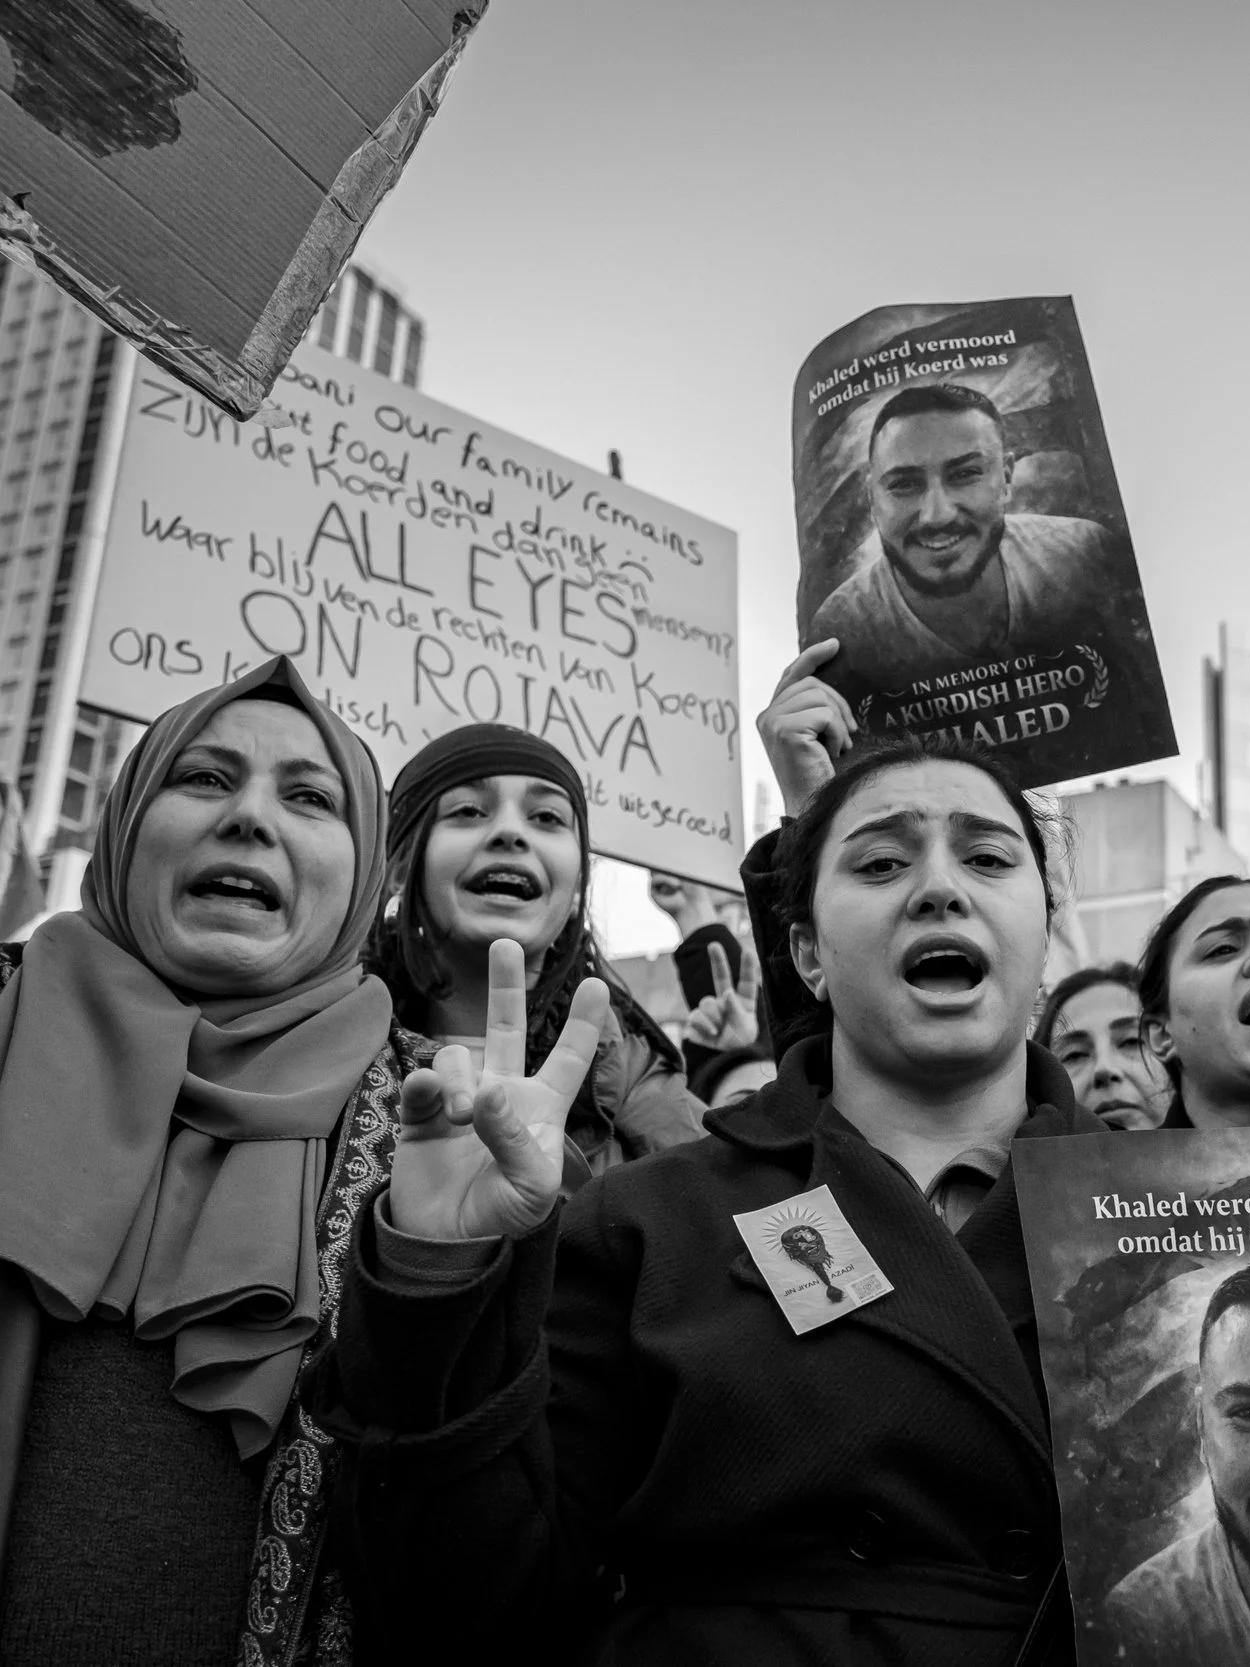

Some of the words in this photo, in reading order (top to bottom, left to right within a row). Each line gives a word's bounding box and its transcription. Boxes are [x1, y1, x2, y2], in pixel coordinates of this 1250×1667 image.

[807, 358, 860, 404] Khaled
[863, 341, 911, 368] werd
[915, 329, 1017, 353] vermoord
[816, 379, 871, 417] omdat
[873, 366, 901, 389] hij
[904, 352, 965, 379] Koerd
[969, 351, 1008, 367] was
[251, 427, 295, 467] de
[328, 421, 410, 485] food
[430, 479, 494, 516] and
[520, 505, 608, 568] drink
[461, 431, 574, 501] family
[583, 490, 704, 567] remains
[304, 501, 435, 598] ALL
[468, 543, 639, 659] EYES
[240, 589, 363, 680] ON
[386, 596, 423, 632] de
[432, 606, 547, 672] rechten
[885, 711, 899, 729] A
[899, 681, 1011, 727] KURDISH
[1014, 664, 1086, 697] HERO
[911, 680, 931, 695] IN
[935, 660, 1010, 690] MEMORY
[1014, 654, 1038, 671] OF
[1091, 1191, 1189, 1220] Khaled
[1117, 1227, 1204, 1254] omdat
[1208, 1225, 1246, 1257] hij
[783, 1287, 797, 1298] JIN
